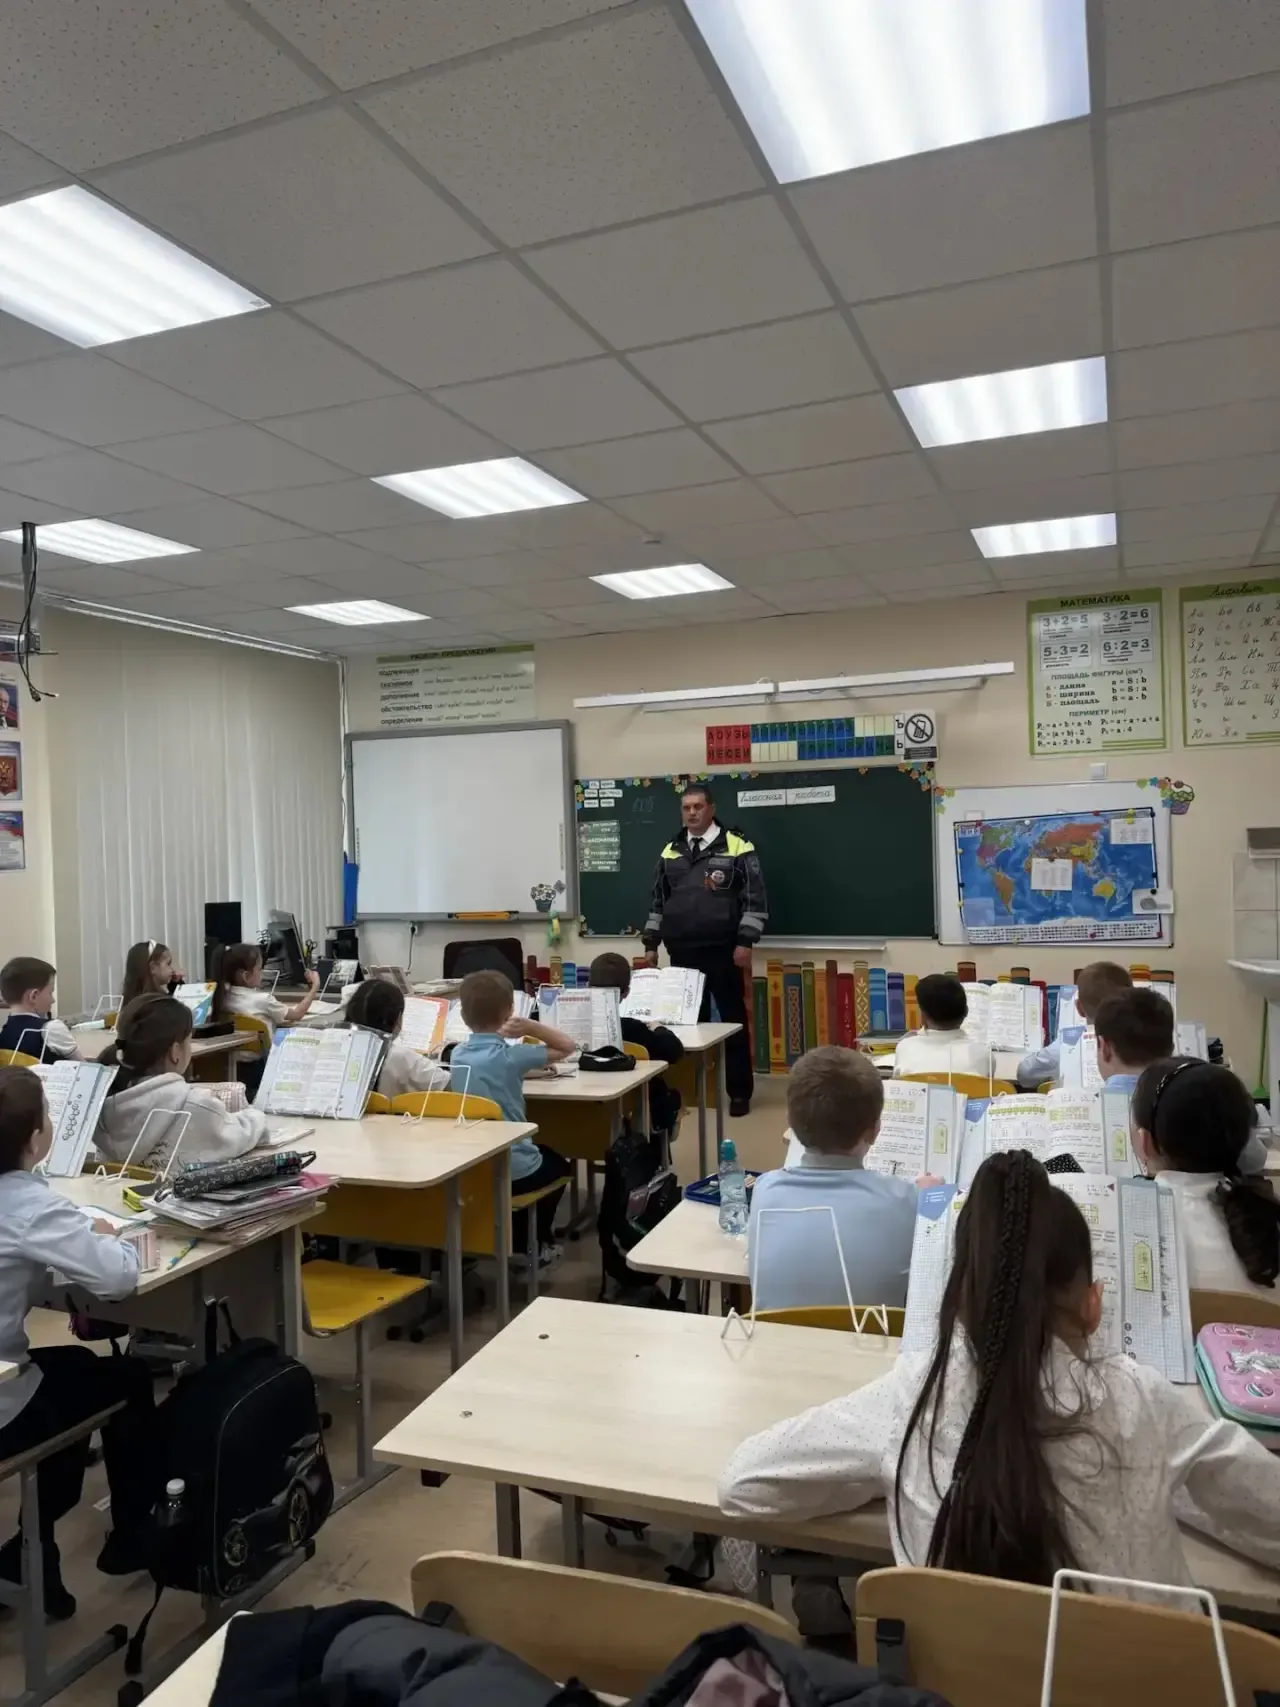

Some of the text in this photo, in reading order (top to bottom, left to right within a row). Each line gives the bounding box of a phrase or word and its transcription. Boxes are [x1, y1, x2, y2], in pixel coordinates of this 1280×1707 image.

[1060, 594, 1130, 608] МАТЕМАТИКА
[1051, 672, 1090, 680] ПЛОЩАДЬ
[1060, 690, 1095, 698] ширина
[1060, 698, 1100, 706] площадь
[1069, 709, 1109, 717] ПЕРИМЕТР
